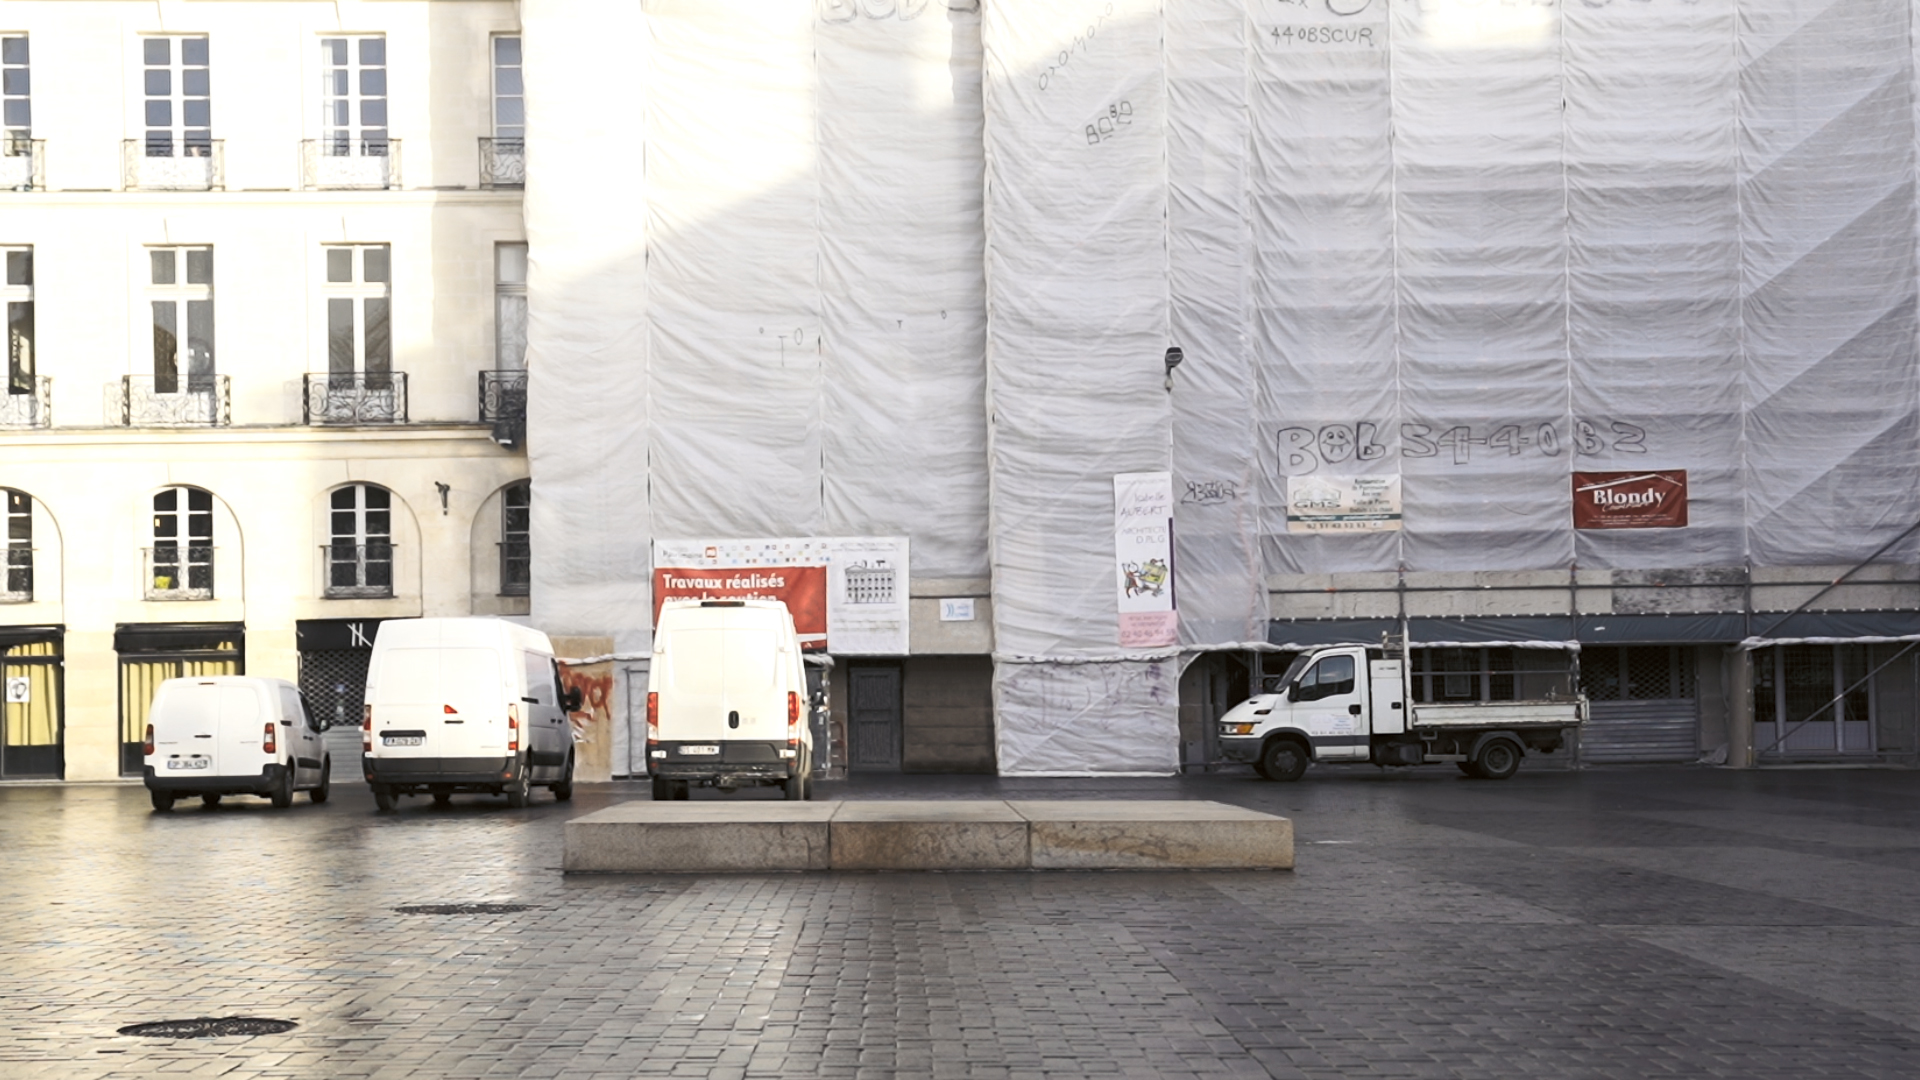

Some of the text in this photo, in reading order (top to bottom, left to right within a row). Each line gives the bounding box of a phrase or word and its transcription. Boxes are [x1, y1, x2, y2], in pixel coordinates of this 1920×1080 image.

[1293, 501, 1341, 509] GMS
[1593, 487, 1666, 507] Blondy
[662, 572, 785, 589] Travaux réalisés
